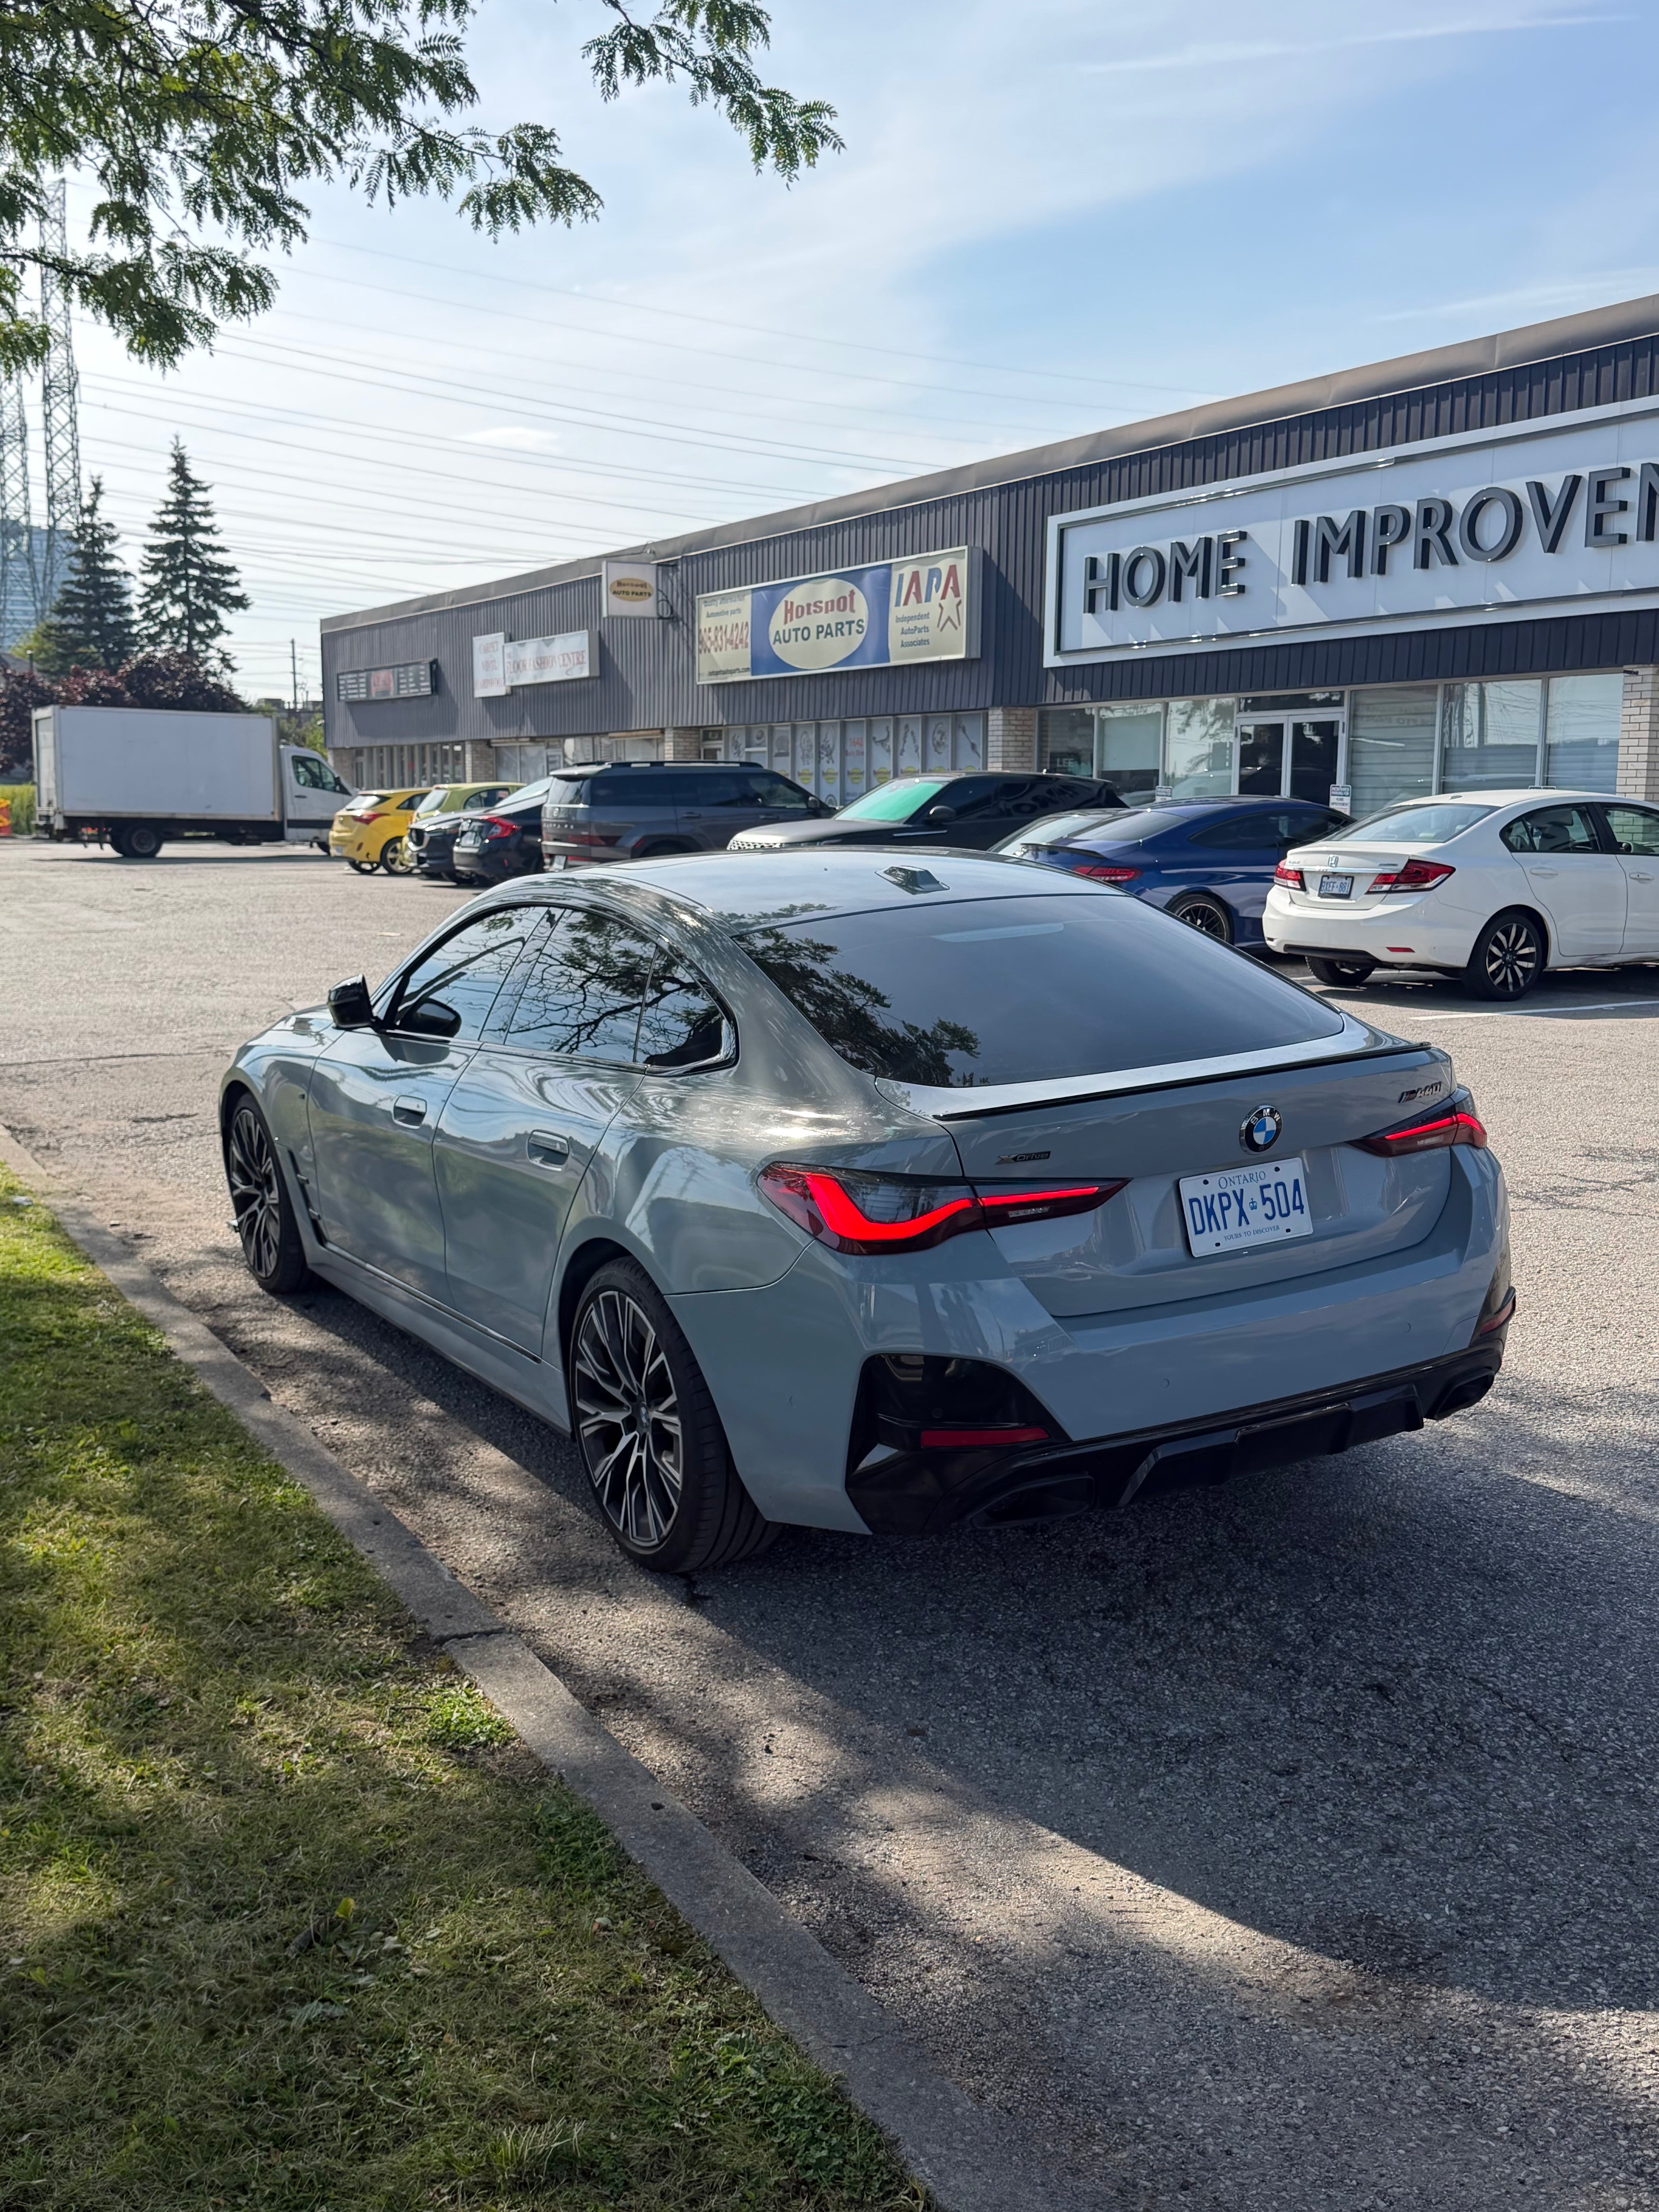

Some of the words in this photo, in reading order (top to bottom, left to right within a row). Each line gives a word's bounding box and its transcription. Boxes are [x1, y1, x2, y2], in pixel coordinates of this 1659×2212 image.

[1083, 529, 1247, 613] HOME
[895, 564, 960, 607] IAPA
[784, 589, 855, 625] Hotspot
[895, 612, 930, 623] Independent
[772, 626, 810, 645] AUTO
[816, 619, 864, 640] PARTS
[900, 625, 929, 636] AutoParts
[900, 638, 930, 648] Associates
[559, 650, 586, 668] CENTRE
[1250, 1108, 1281, 1125] BMW
[1218, 1171, 1266, 1189] ONTARIO
[1189, 1189, 1250, 1235] DKPX
[1259, 1179, 1304, 1220] 504
[1224, 1232, 1242, 1241] YOURS
[1253, 1225, 1280, 1235] DISCOVER
